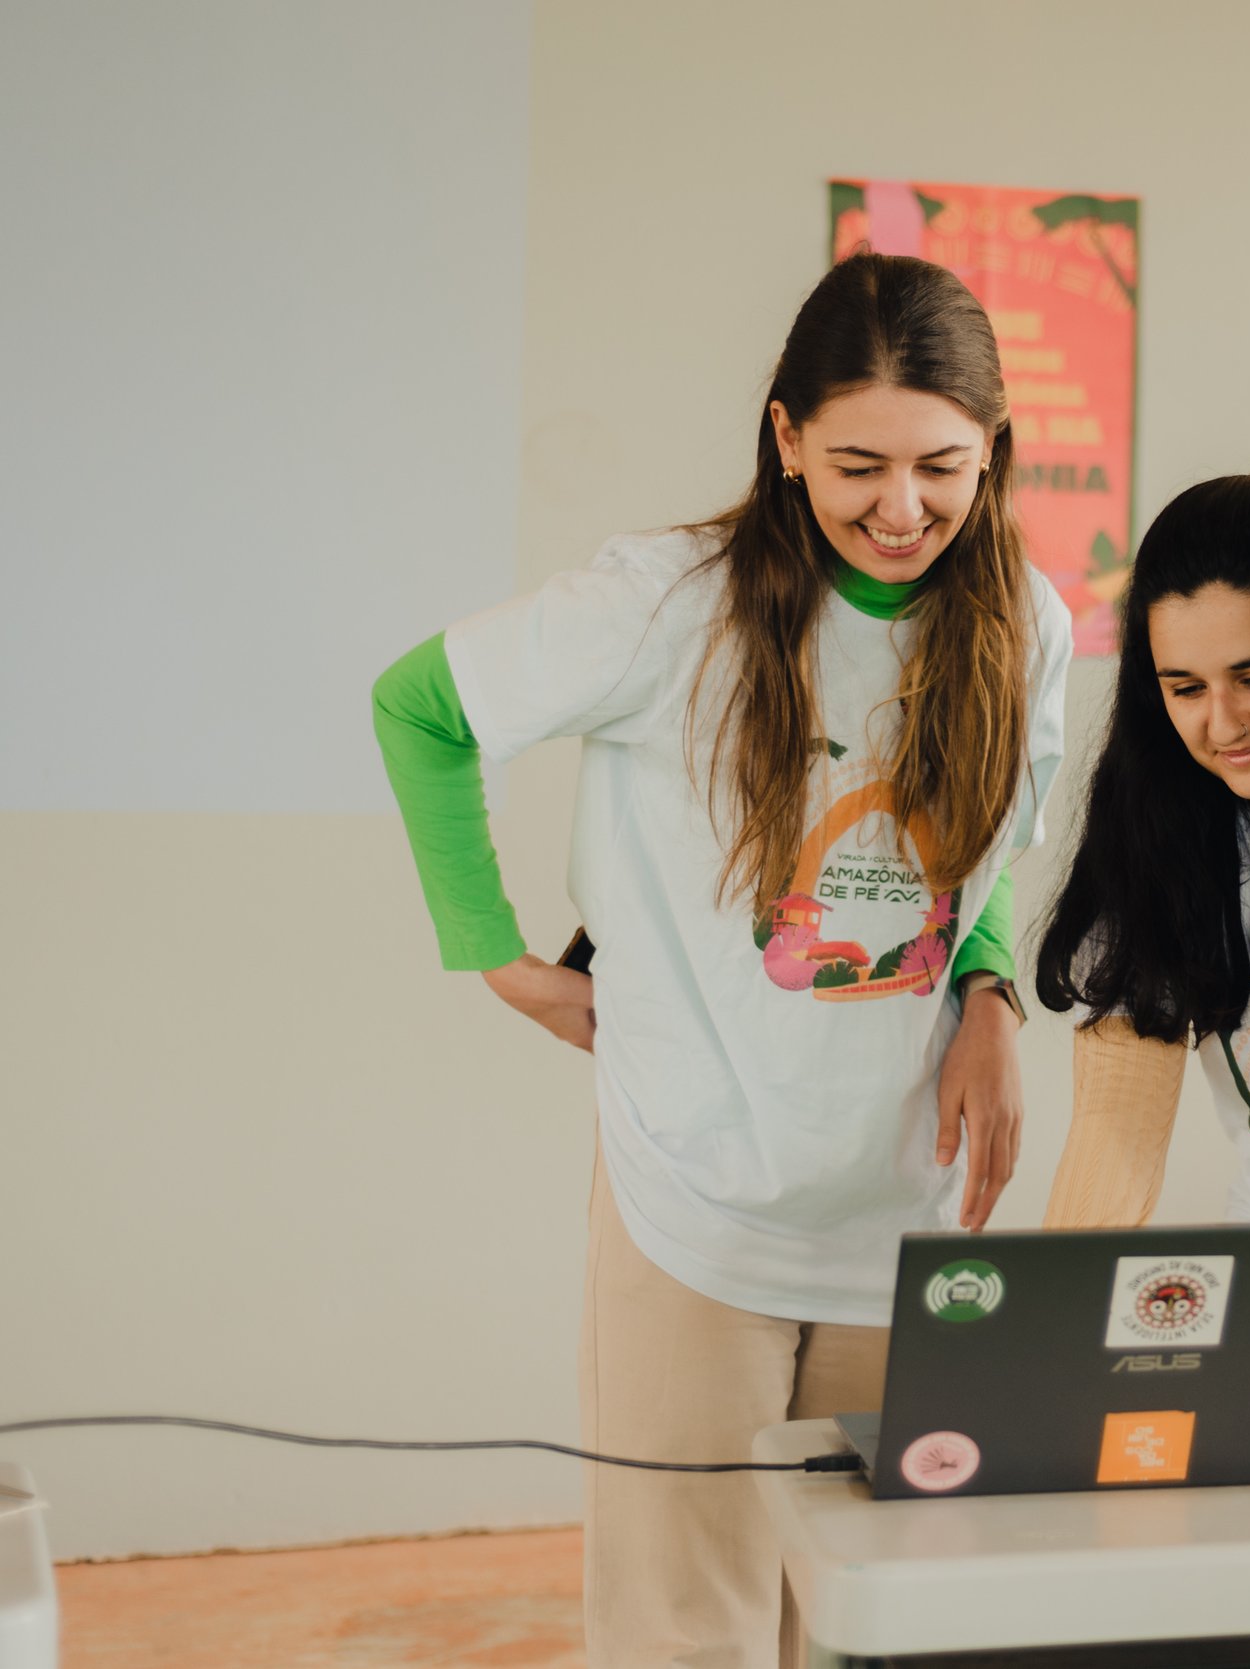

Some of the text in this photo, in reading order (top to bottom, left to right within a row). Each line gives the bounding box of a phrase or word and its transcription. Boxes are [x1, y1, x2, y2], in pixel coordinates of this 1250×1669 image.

[837, 853, 867, 862] VIRADA
[821, 864, 923, 885] AMAZÔNIA
[819, 883, 881, 901] DE PÉ
[1110, 1352, 1202, 1373] ASUS
